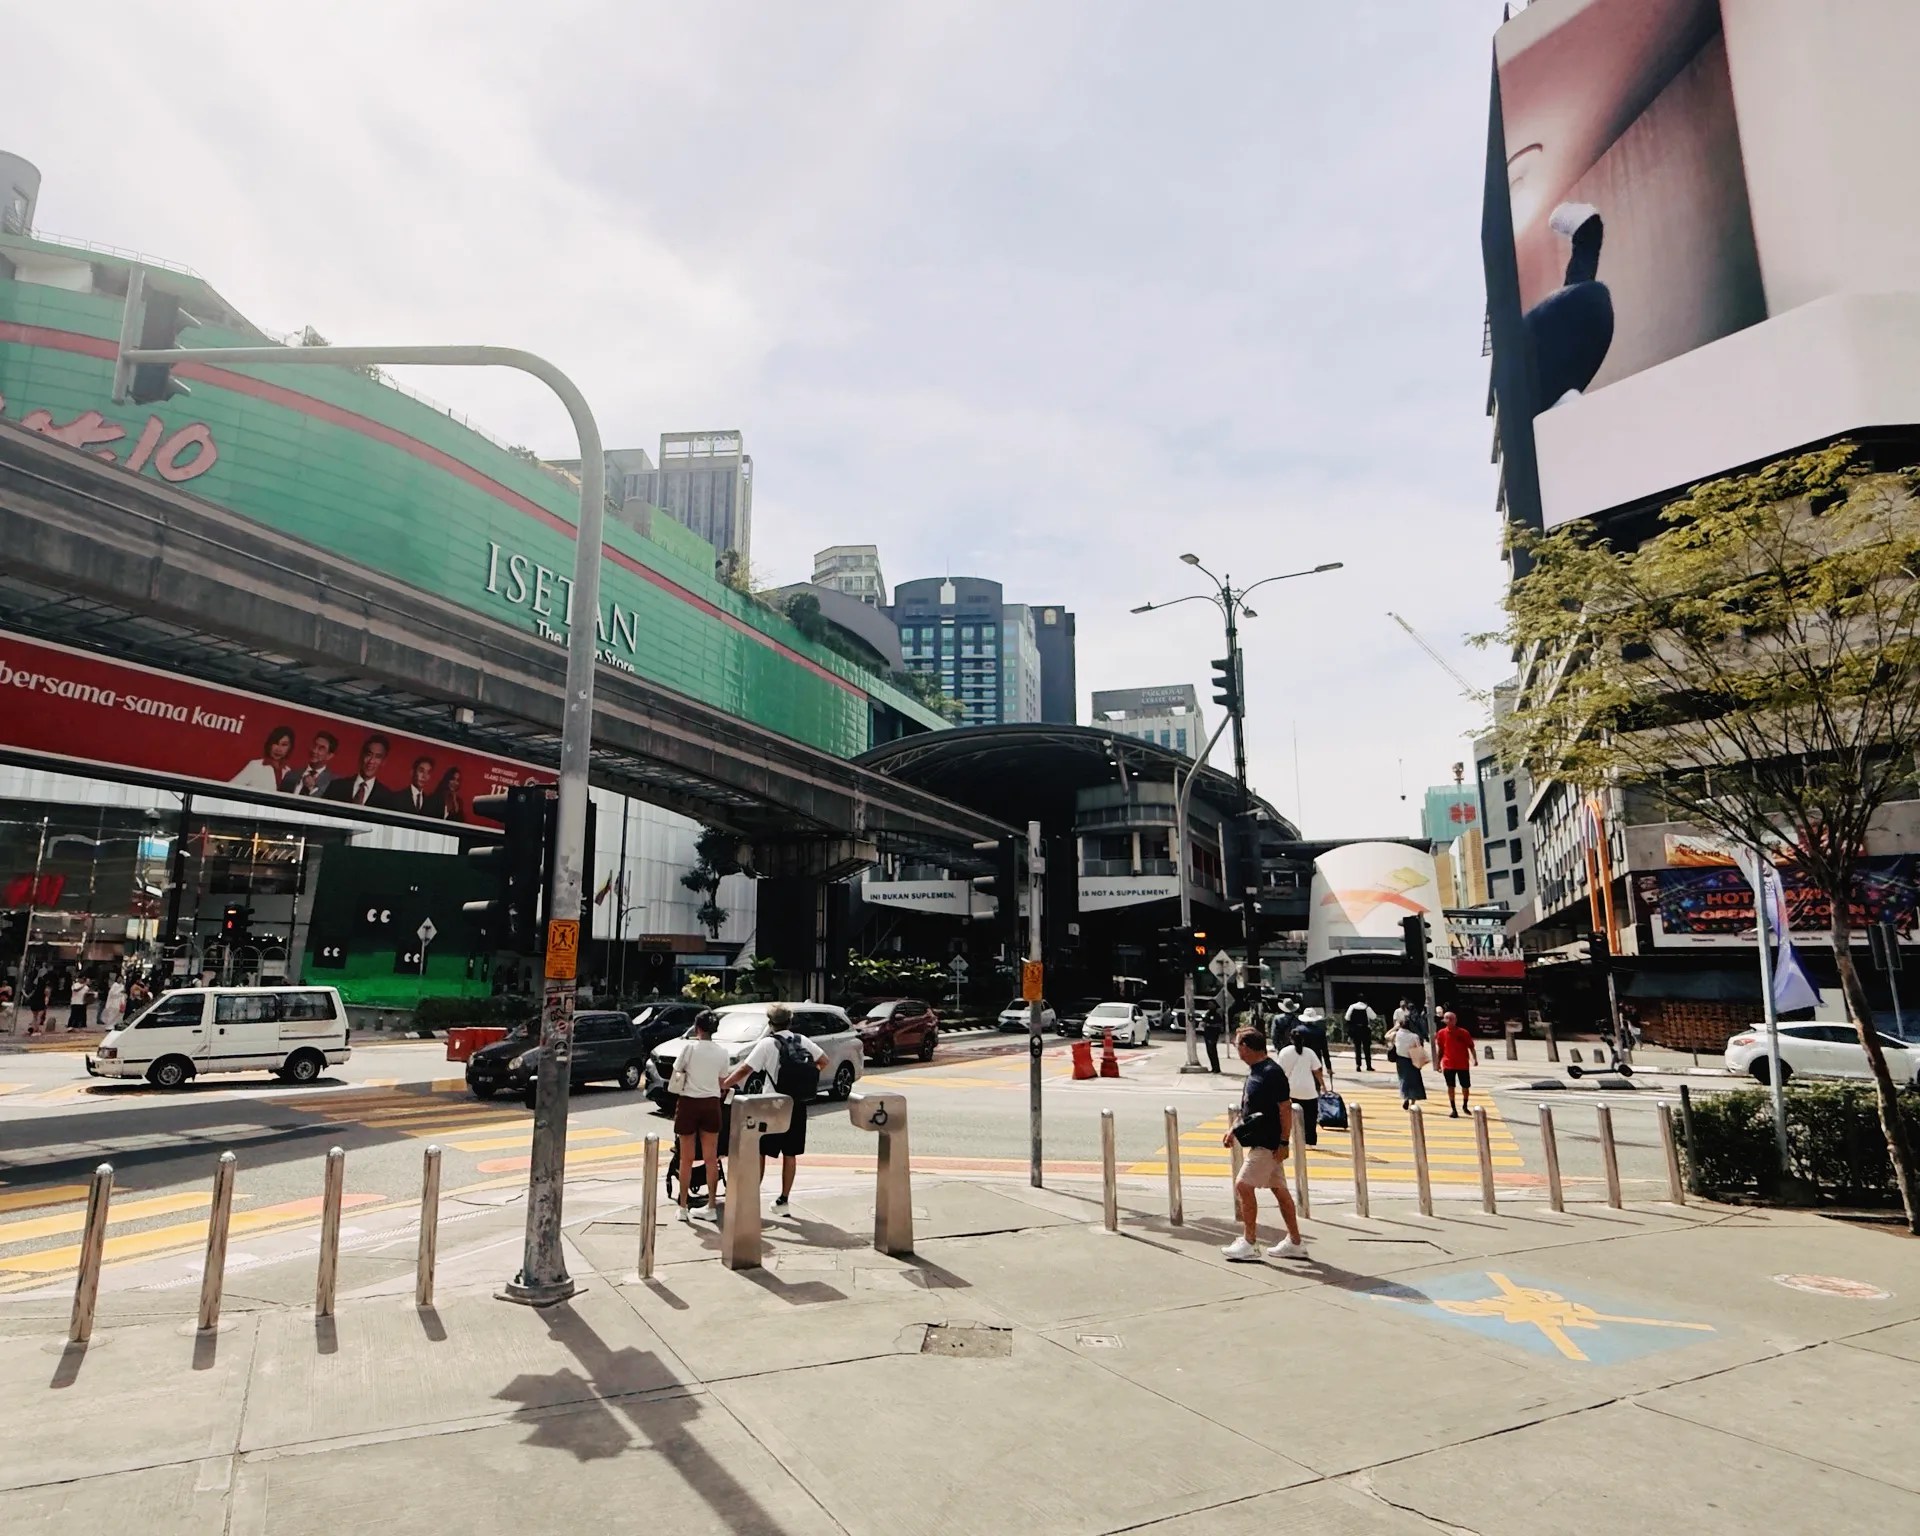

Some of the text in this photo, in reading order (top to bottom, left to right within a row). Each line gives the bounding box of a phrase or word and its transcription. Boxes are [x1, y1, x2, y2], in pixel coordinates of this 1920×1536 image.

[0, 660, 246, 735] bersama-sama kami
[911, 892, 957, 900] SUPLEMEN.
[1707, 892, 1752, 905] HOT
